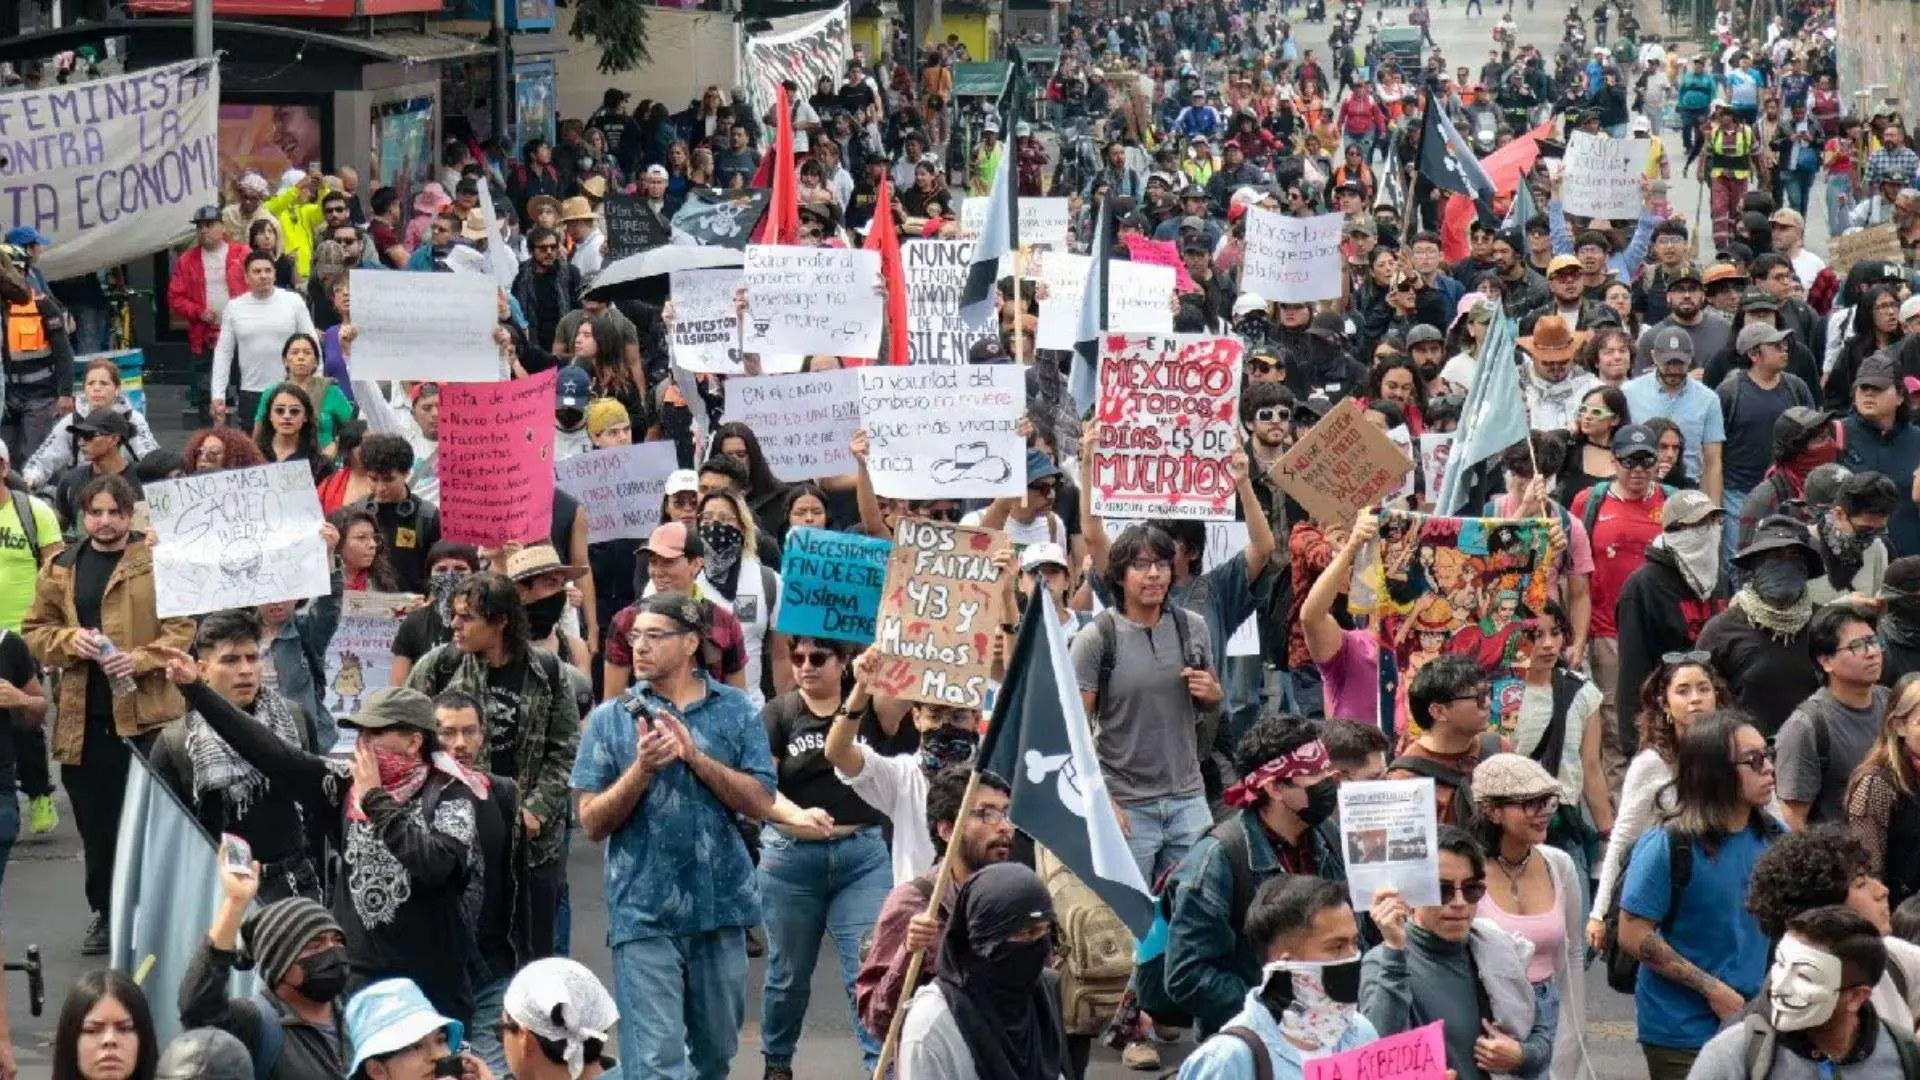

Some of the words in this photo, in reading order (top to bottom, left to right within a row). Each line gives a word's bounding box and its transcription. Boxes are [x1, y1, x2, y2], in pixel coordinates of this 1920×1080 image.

[140, 109, 179, 154] LA
[909, 243, 975, 267] NUNC
[911, 268, 967, 286] TENDRA
[1146, 336, 1176, 351] EN
[969, 366, 995, 388] del
[1101, 353, 1232, 396] MÉXICO
[1128, 391, 1213, 418] TODOS
[1000, 420, 1016, 433] qu
[1171, 428, 1193, 449] ES
[1203, 430, 1227, 451] DE
[1093, 450, 1236, 499] MUERTOS
[898, 520, 956, 551] NOS
[907, 577, 949, 618] 43
[880, 616, 970, 665] Muchos
